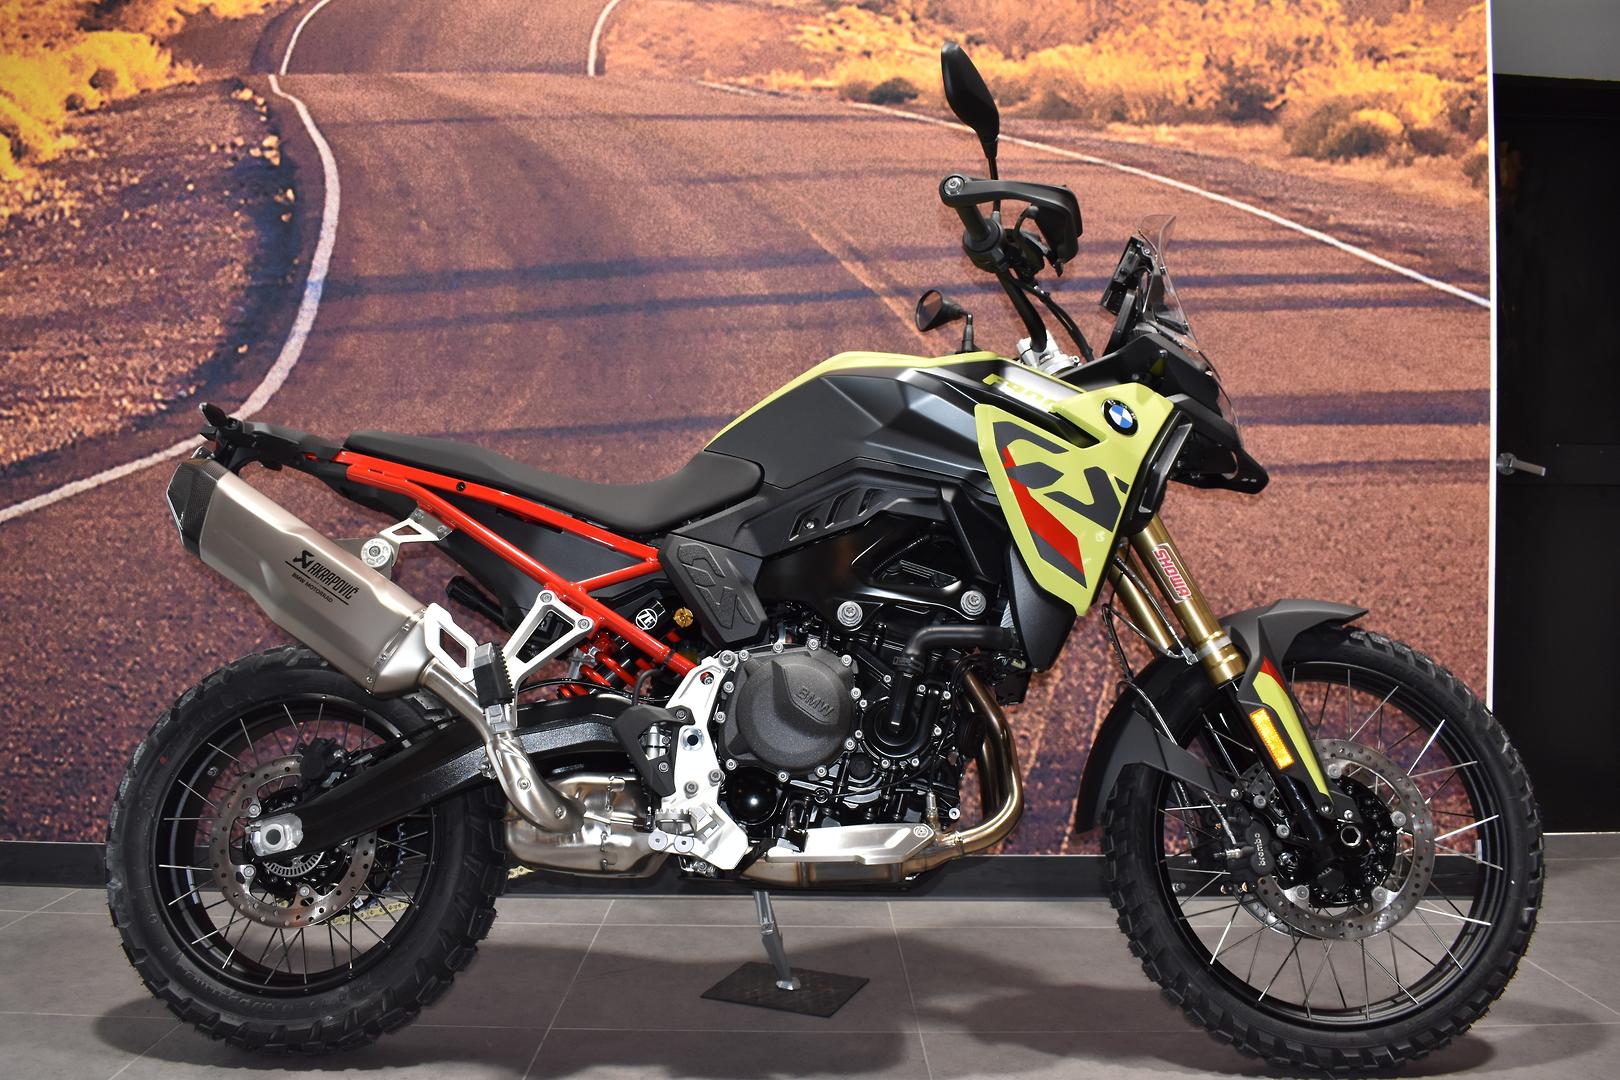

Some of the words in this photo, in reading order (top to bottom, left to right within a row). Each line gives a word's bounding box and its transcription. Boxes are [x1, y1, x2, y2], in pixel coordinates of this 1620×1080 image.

[291, 572, 305, 585] BMW
[304, 580, 334, 603] MOTORRAD
[1152, 548, 1191, 598] SHOWA
[795, 685, 835, 717] BMW
[1254, 832, 1266, 867] brembo
